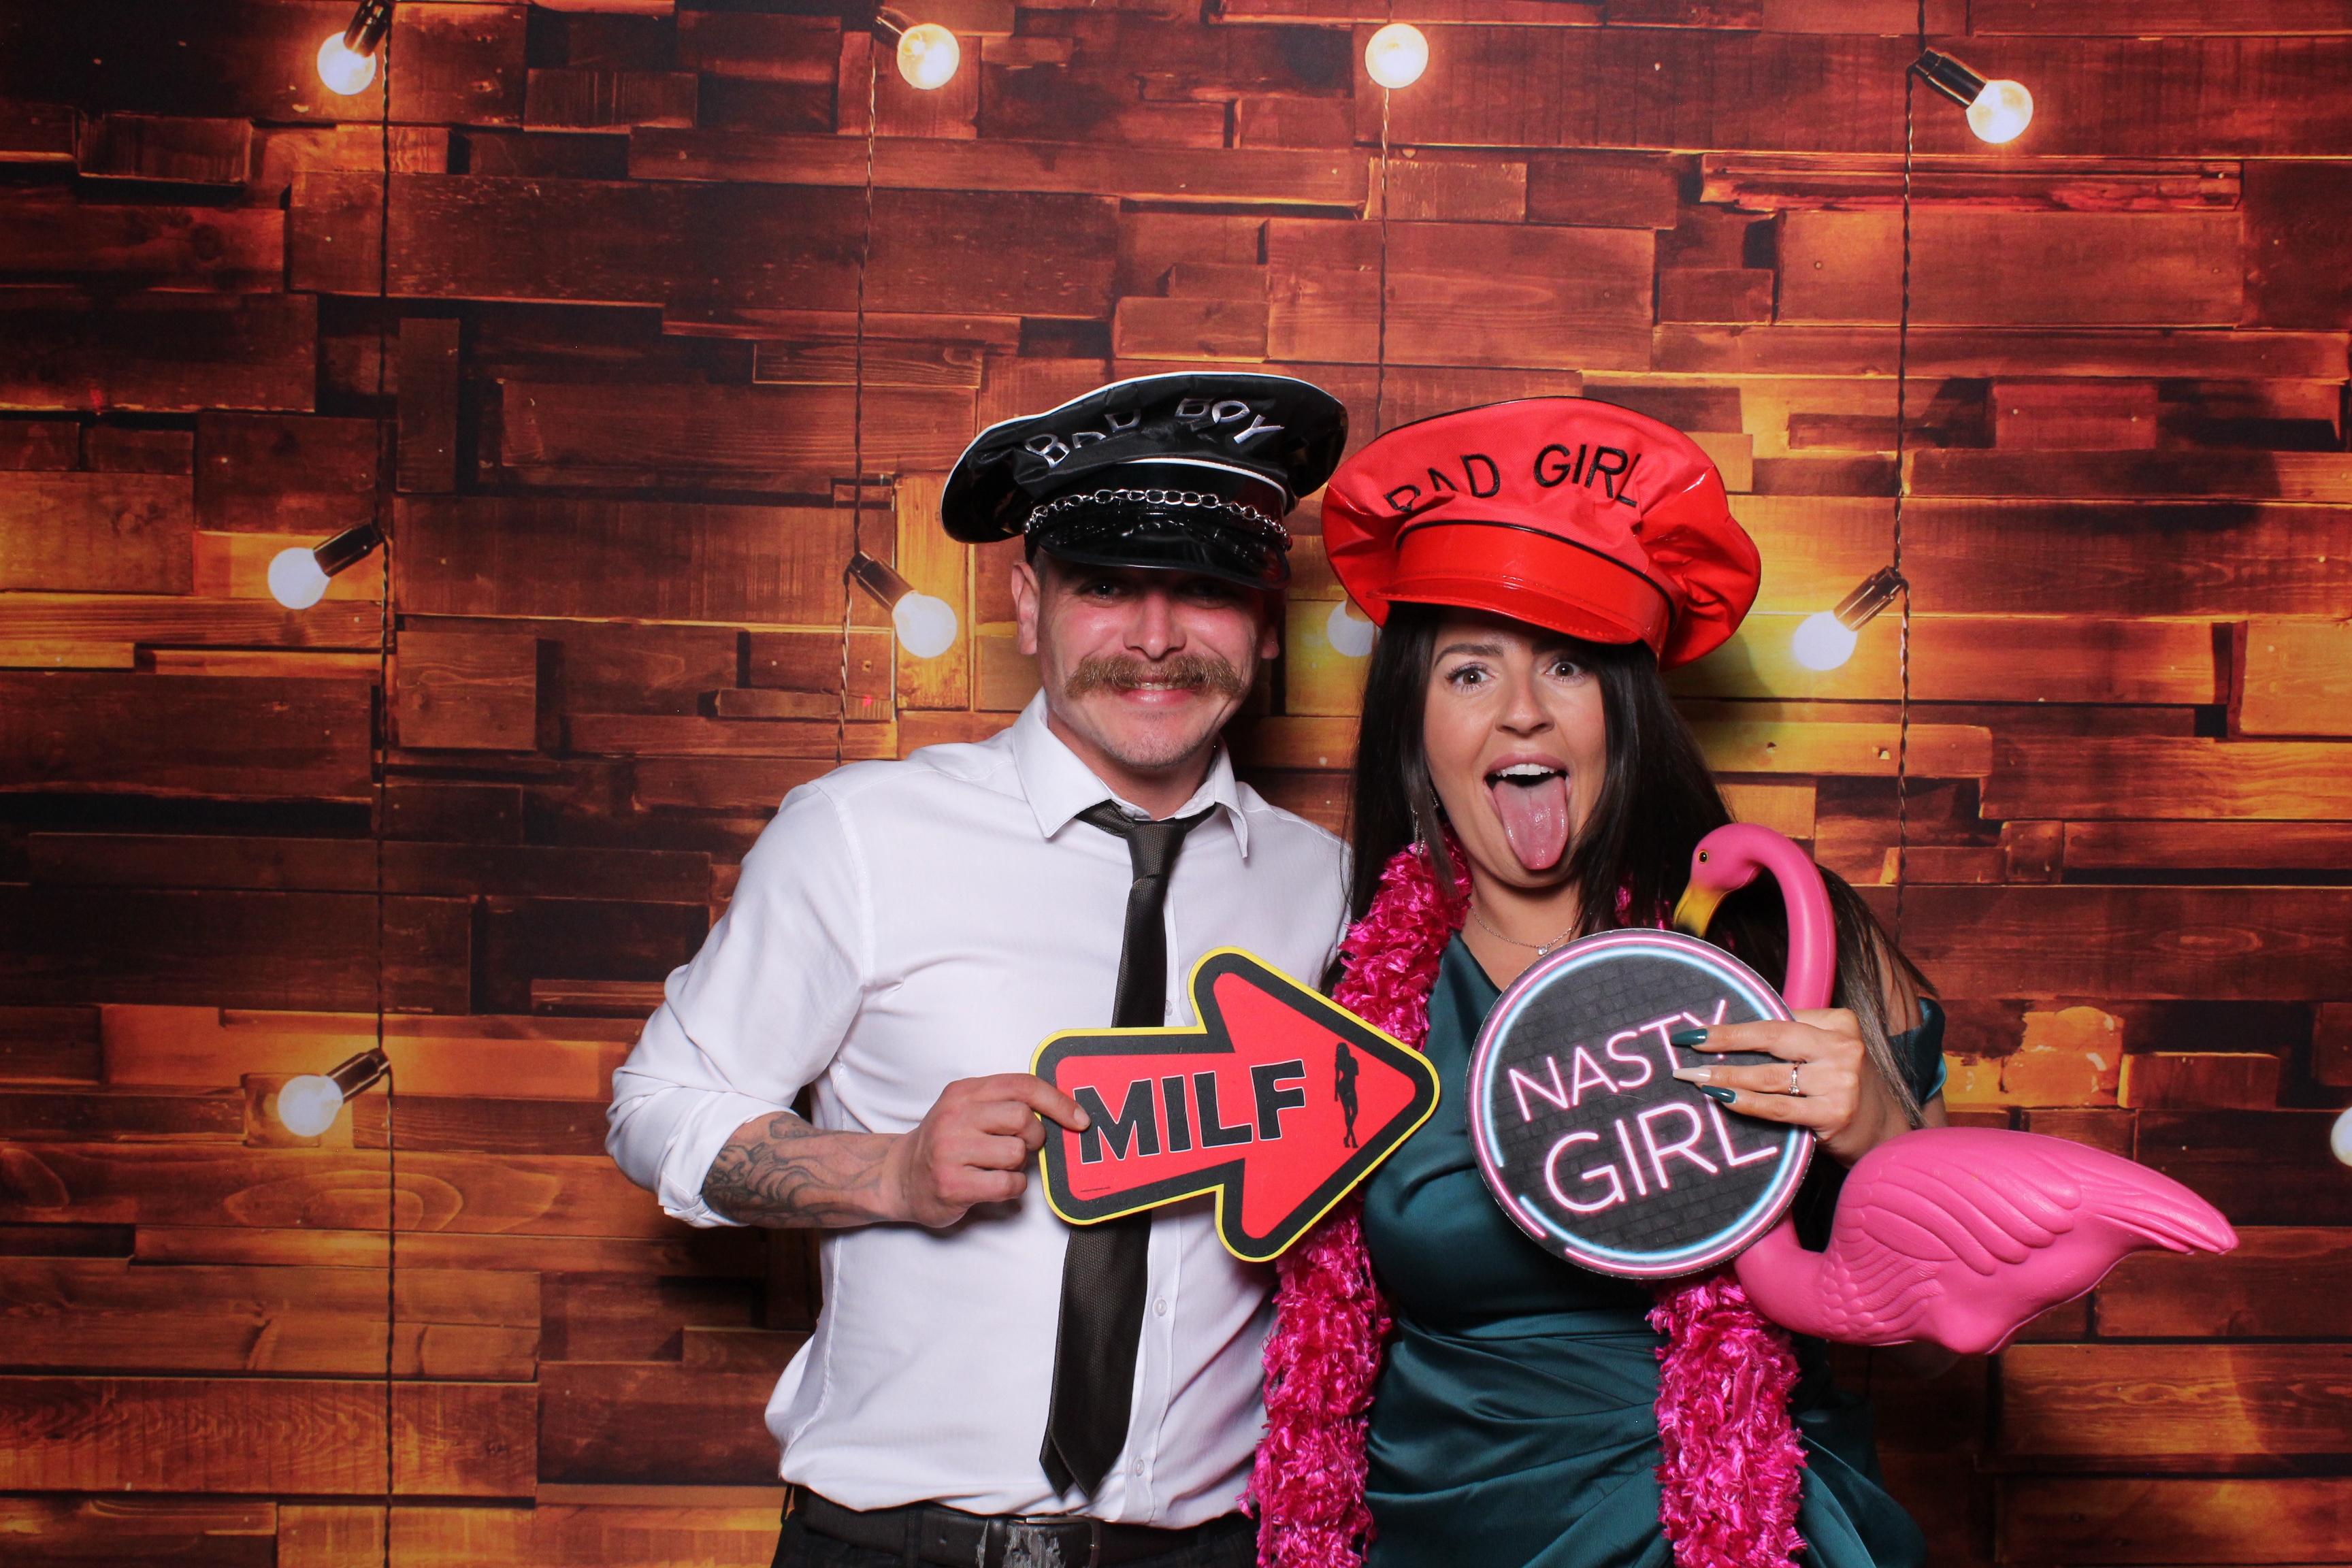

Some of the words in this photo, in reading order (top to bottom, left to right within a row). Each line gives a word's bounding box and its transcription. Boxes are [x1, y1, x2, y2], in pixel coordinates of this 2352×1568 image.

[1024, 410, 1141, 468] BAD
[1175, 398, 1285, 444] BOY
[1383, 453, 1501, 513] BAD
[1533, 444, 1642, 508] GIRL
[1073, 1058, 1306, 1165] MILF
[1544, 1092, 1778, 1212] GIRL
